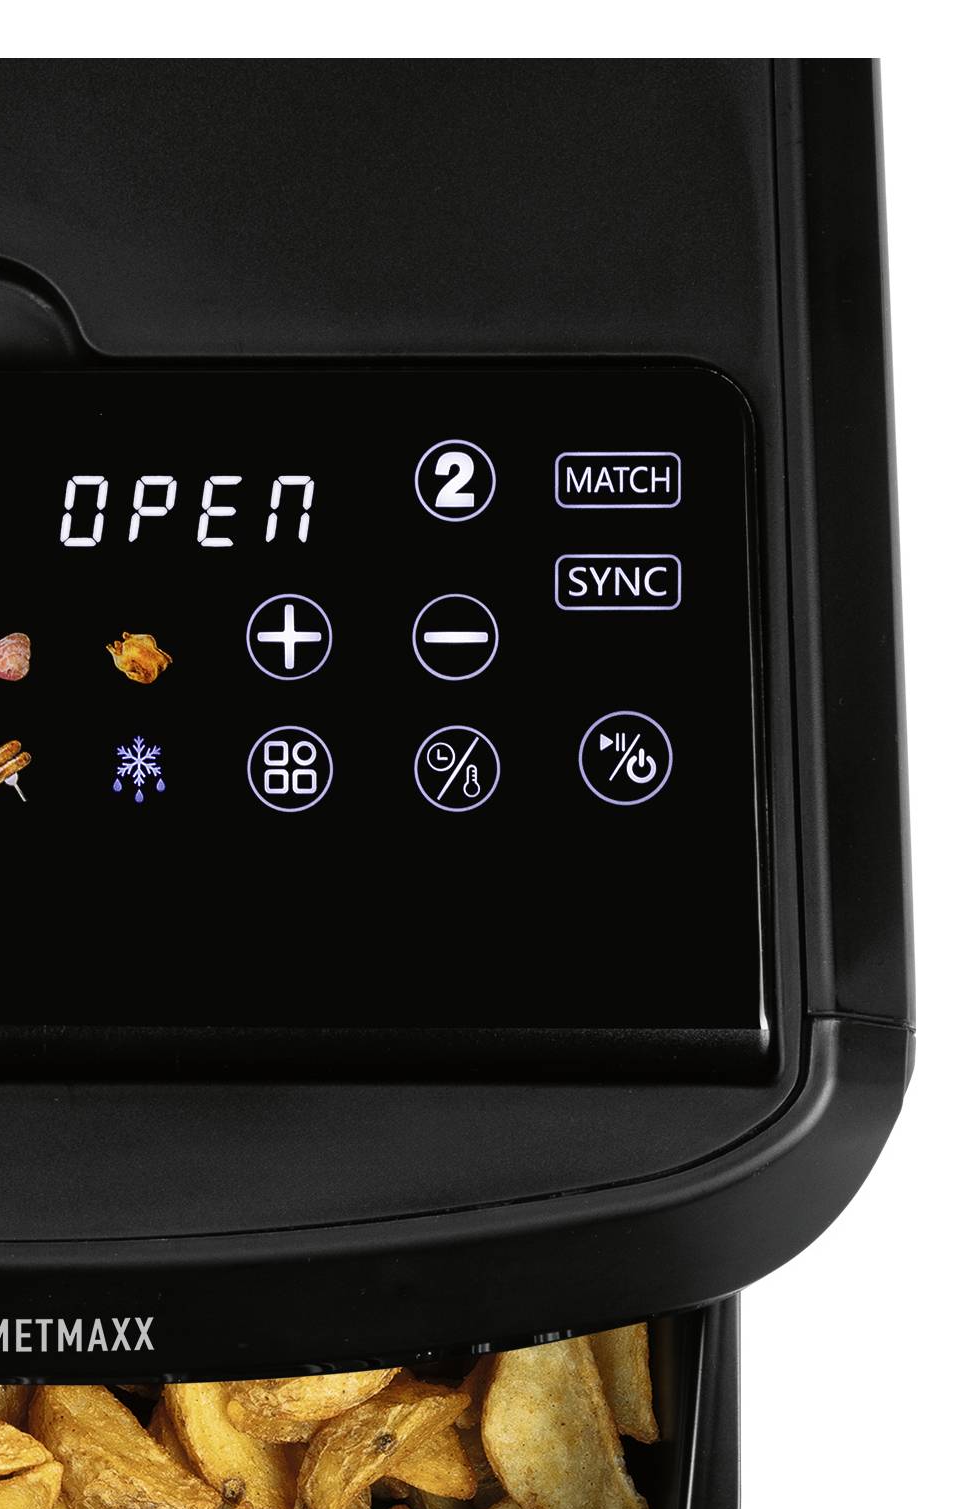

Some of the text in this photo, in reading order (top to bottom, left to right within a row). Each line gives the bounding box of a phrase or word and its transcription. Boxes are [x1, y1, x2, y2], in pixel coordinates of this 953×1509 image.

[434, 451, 476, 508] 2
[566, 465, 671, 495] MATCH
[59, 475, 315, 548] OPEN
[567, 566, 668, 598] SYNC
